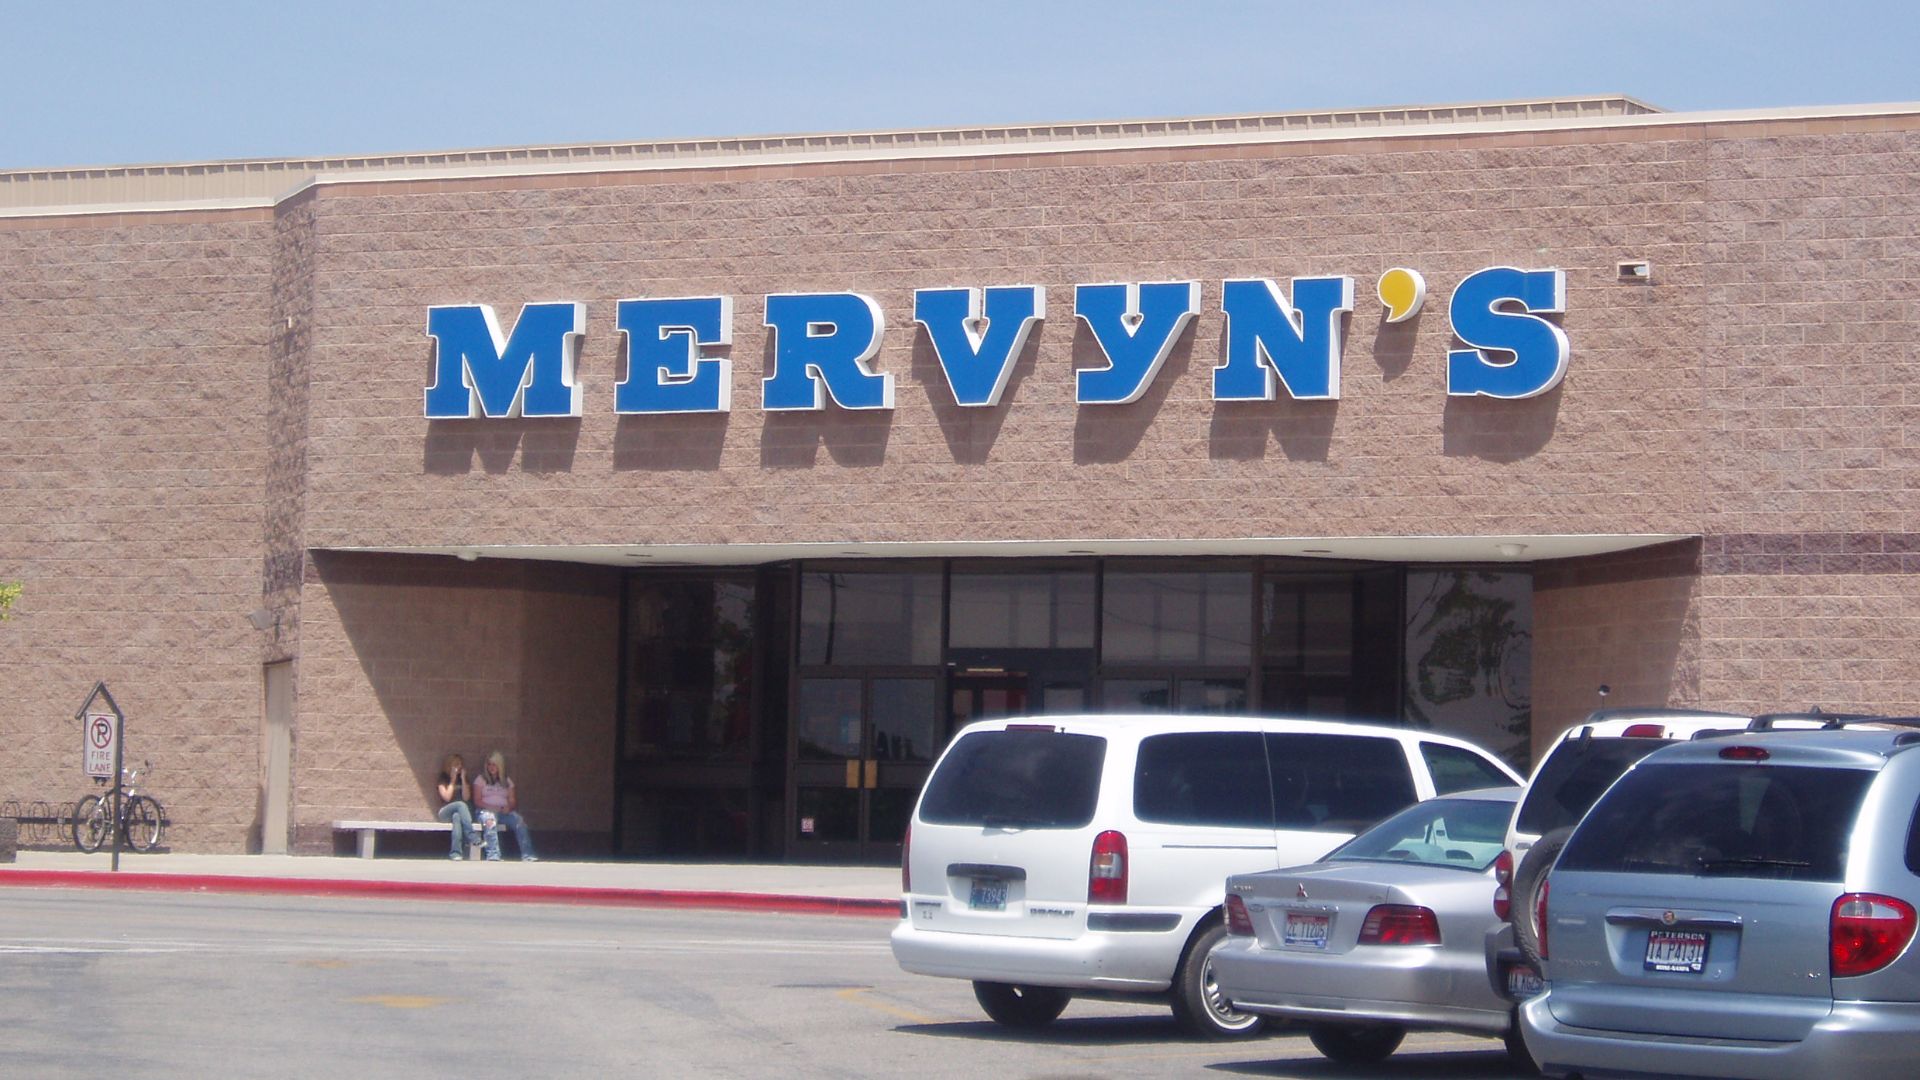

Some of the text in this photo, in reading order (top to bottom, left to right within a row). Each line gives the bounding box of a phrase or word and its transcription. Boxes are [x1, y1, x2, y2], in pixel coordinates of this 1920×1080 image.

[424, 265, 1571, 421] MERVYN'S
[91, 751, 110, 761] FIRE
[89, 763, 111, 772] LANE
